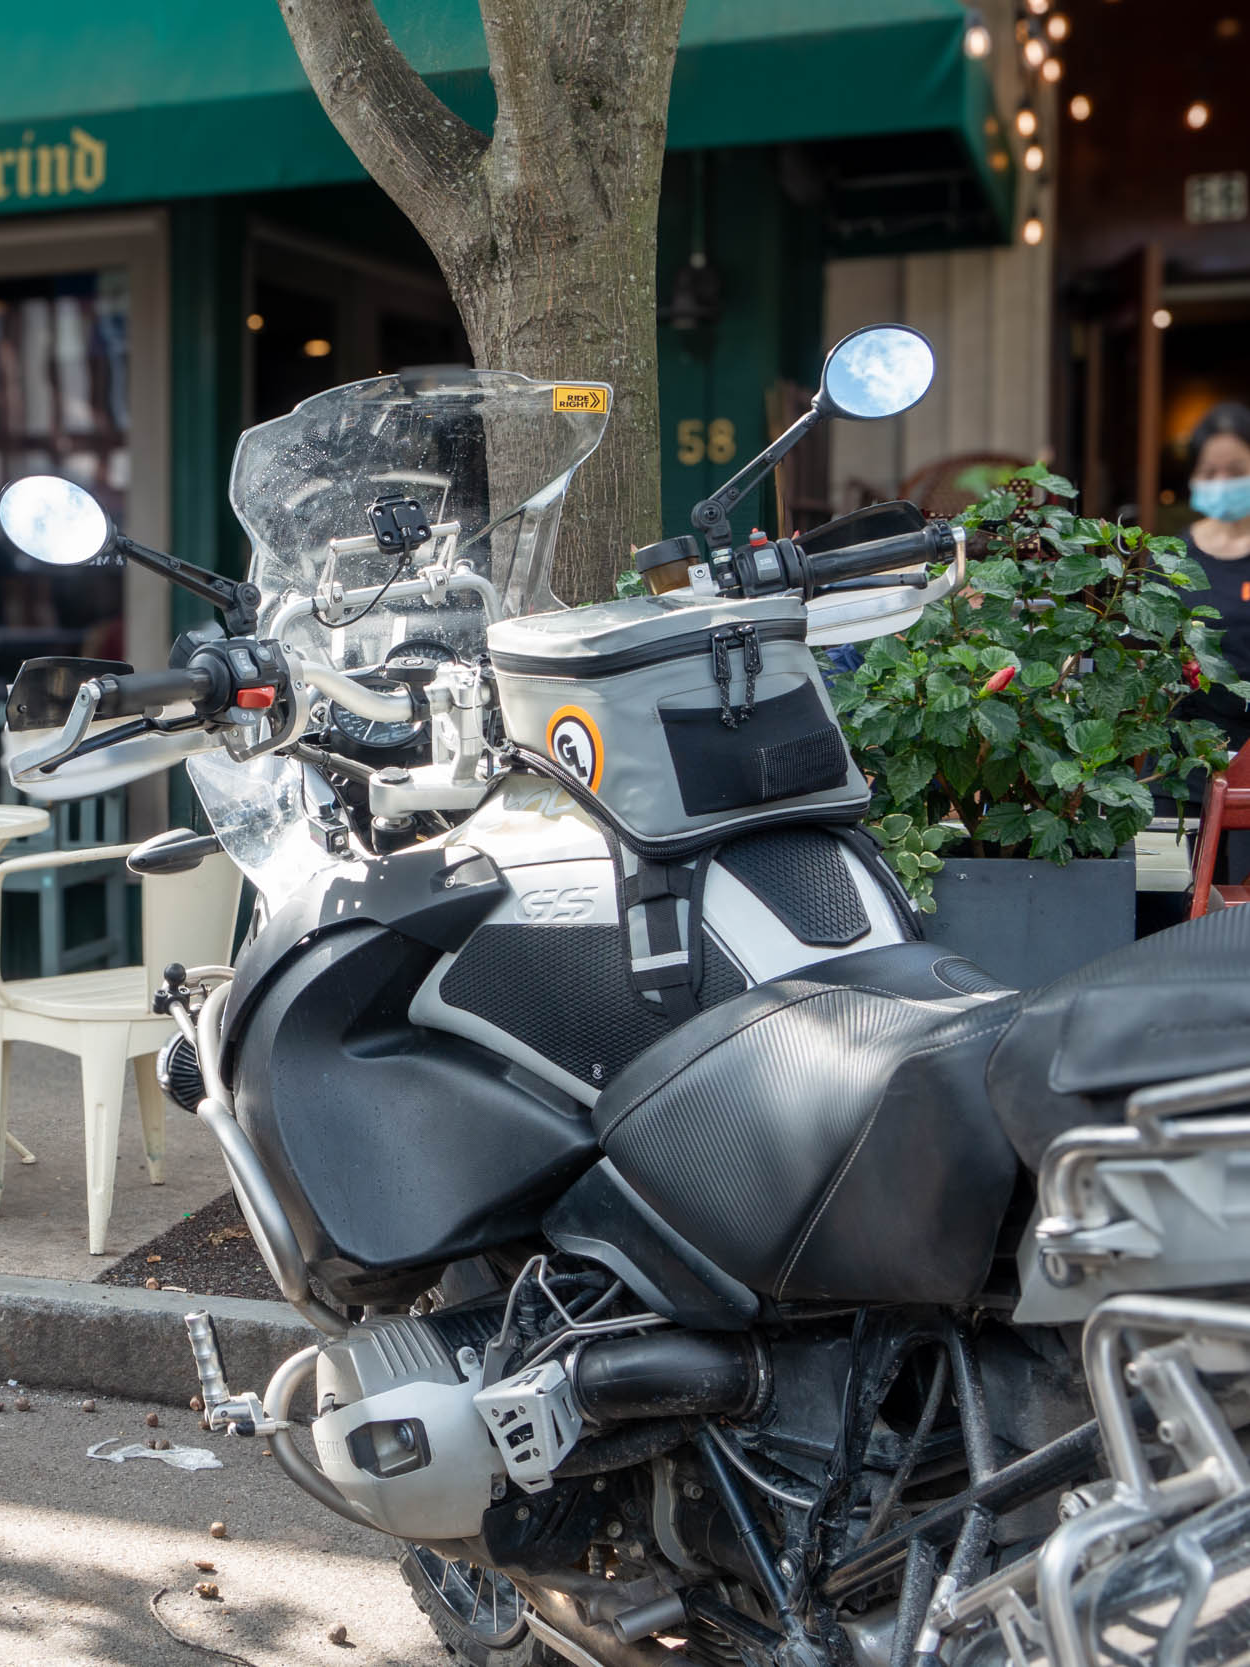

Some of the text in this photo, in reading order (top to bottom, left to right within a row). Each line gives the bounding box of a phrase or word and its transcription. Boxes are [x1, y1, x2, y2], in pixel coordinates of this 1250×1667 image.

[559, 400, 589, 408] RIGHT
[567, 394, 589, 402] RIDE
[677, 418, 736, 466] 58
[513, 886, 598, 922] GS
